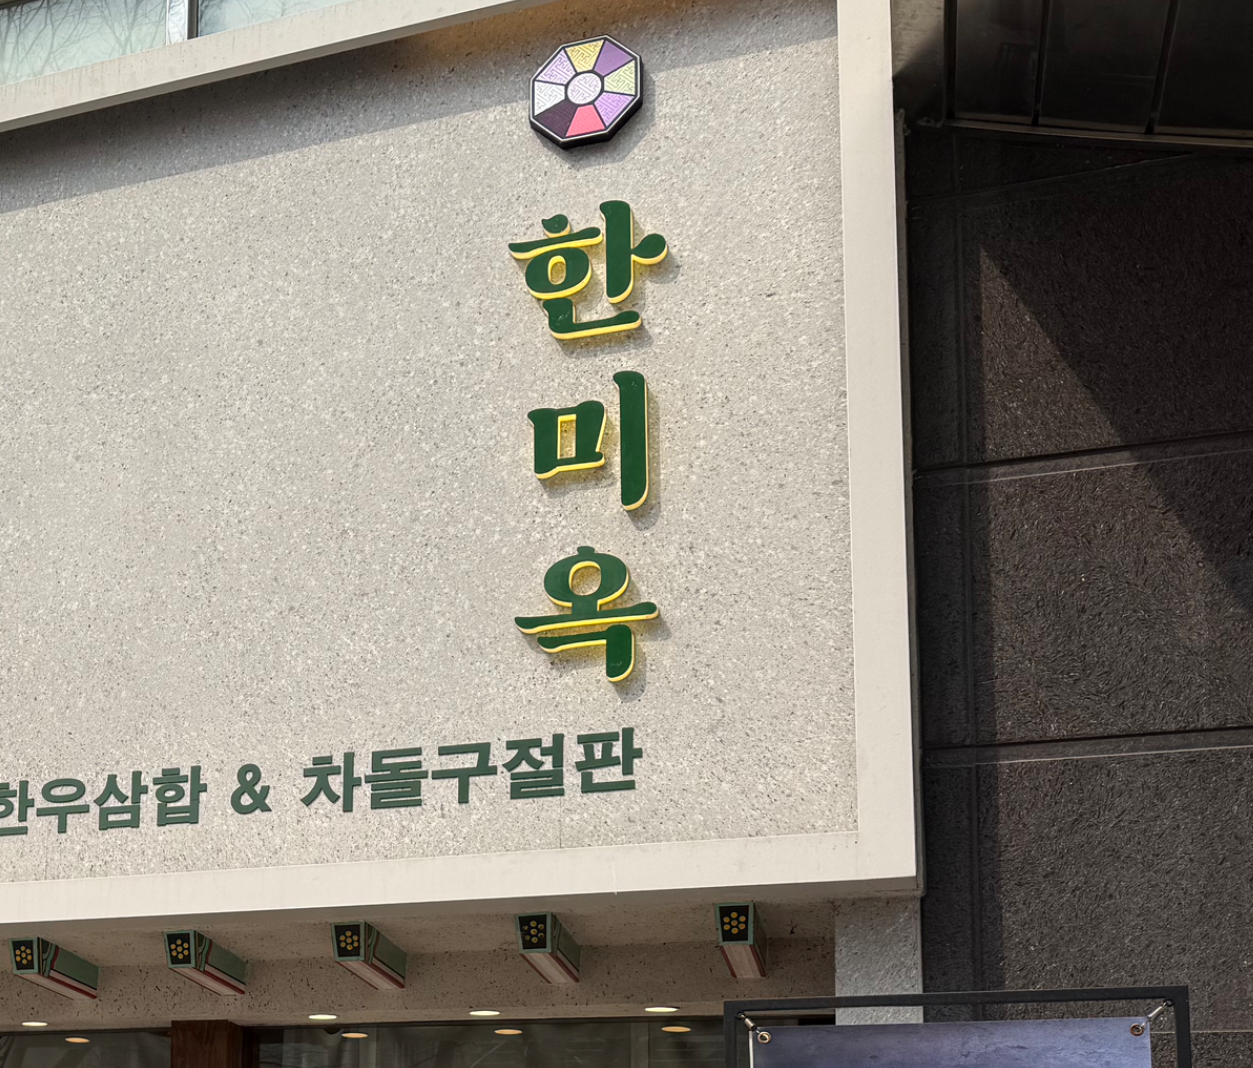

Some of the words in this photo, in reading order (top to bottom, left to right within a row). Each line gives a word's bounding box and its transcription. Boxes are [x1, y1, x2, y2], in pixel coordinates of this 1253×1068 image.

[508, 199, 668, 682] 한미옥
[230, 762, 272, 816] &
[301, 726, 643, 813] 차돌구절판
